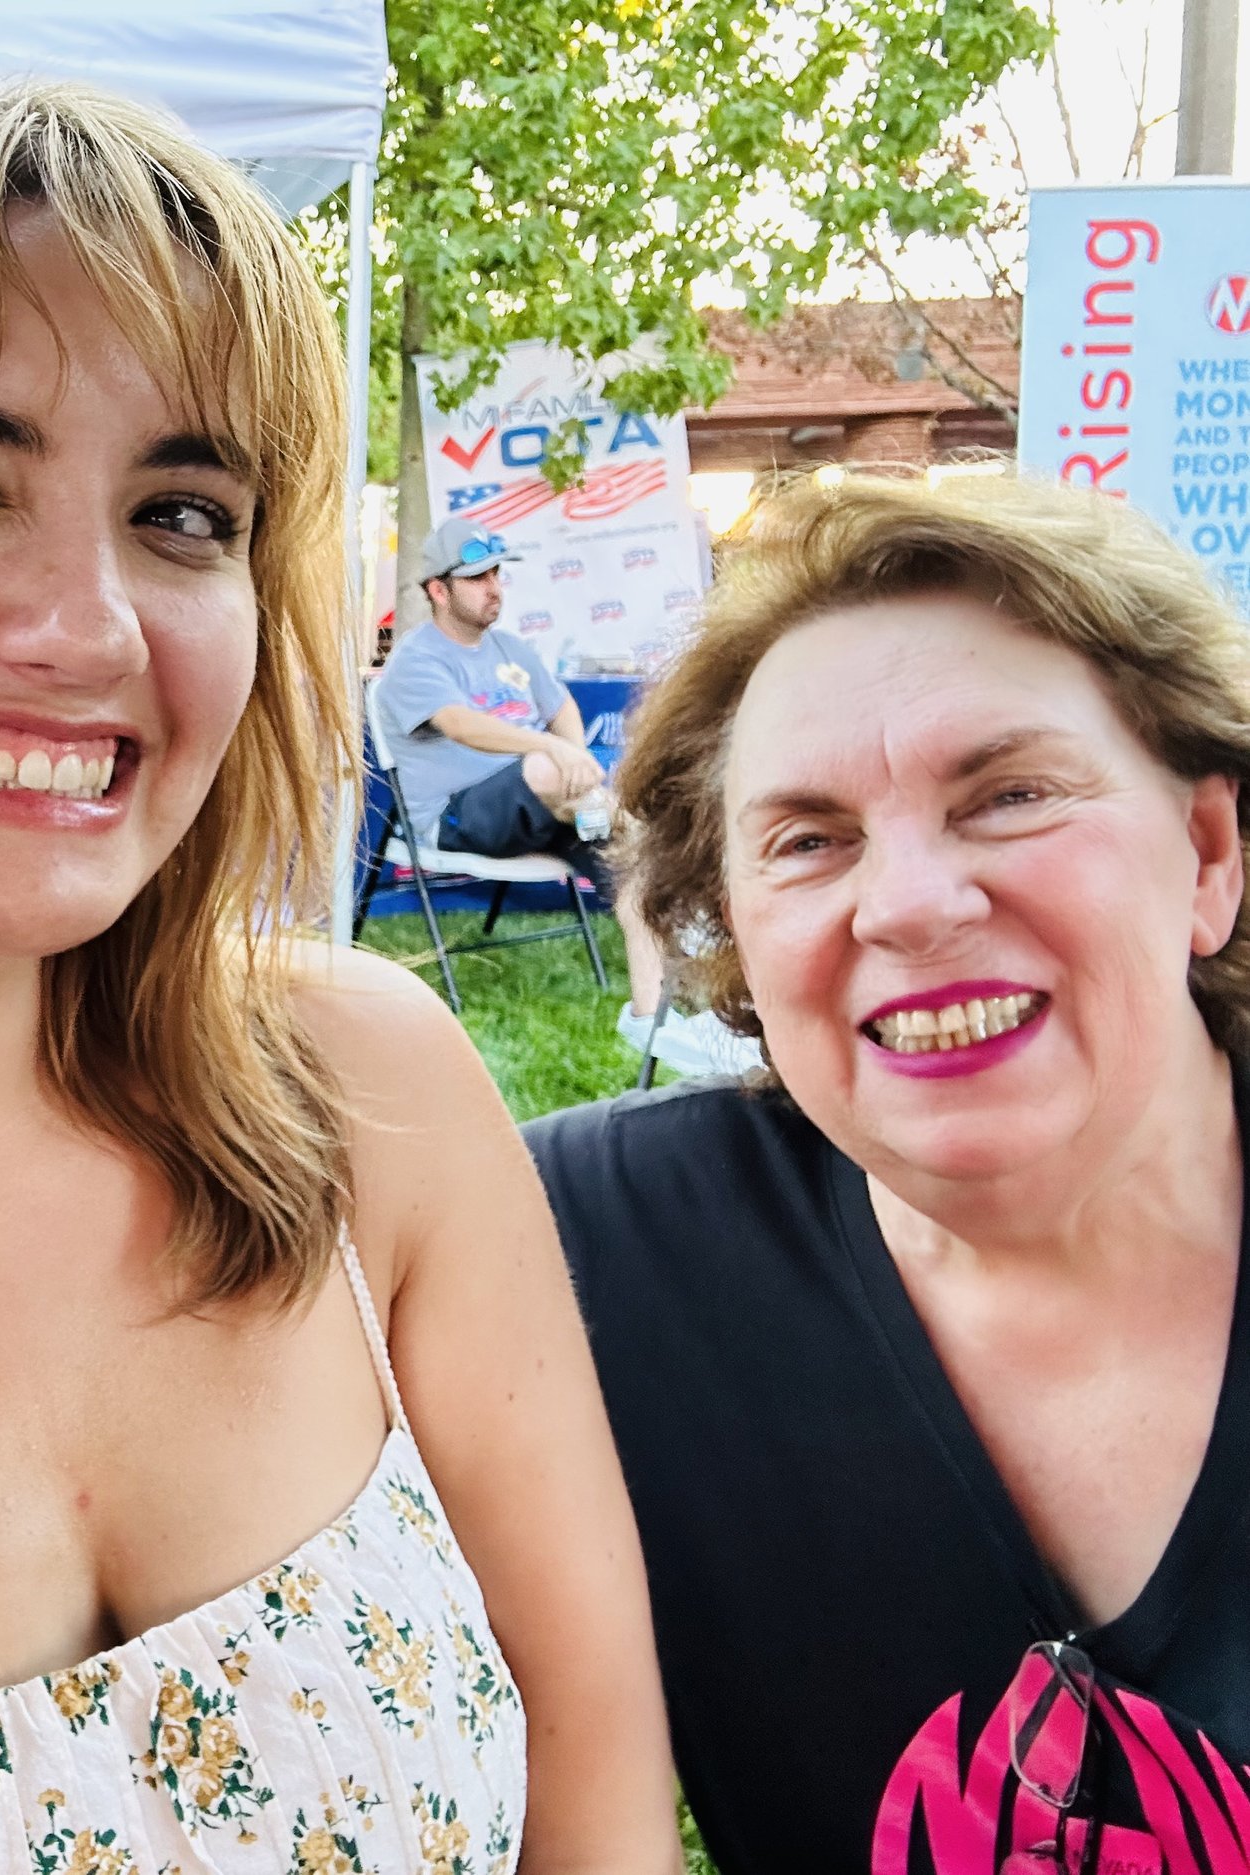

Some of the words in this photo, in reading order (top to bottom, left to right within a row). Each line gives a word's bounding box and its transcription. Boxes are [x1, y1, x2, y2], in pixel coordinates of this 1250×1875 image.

[1058, 218, 1160, 499] Rising
[1178, 359, 1250, 383] WHE
[1175, 389, 1250, 418] MON
[1174, 426, 1230, 447] AND
[1173, 452, 1250, 476] PEOP
[1173, 482, 1250, 517] WH
